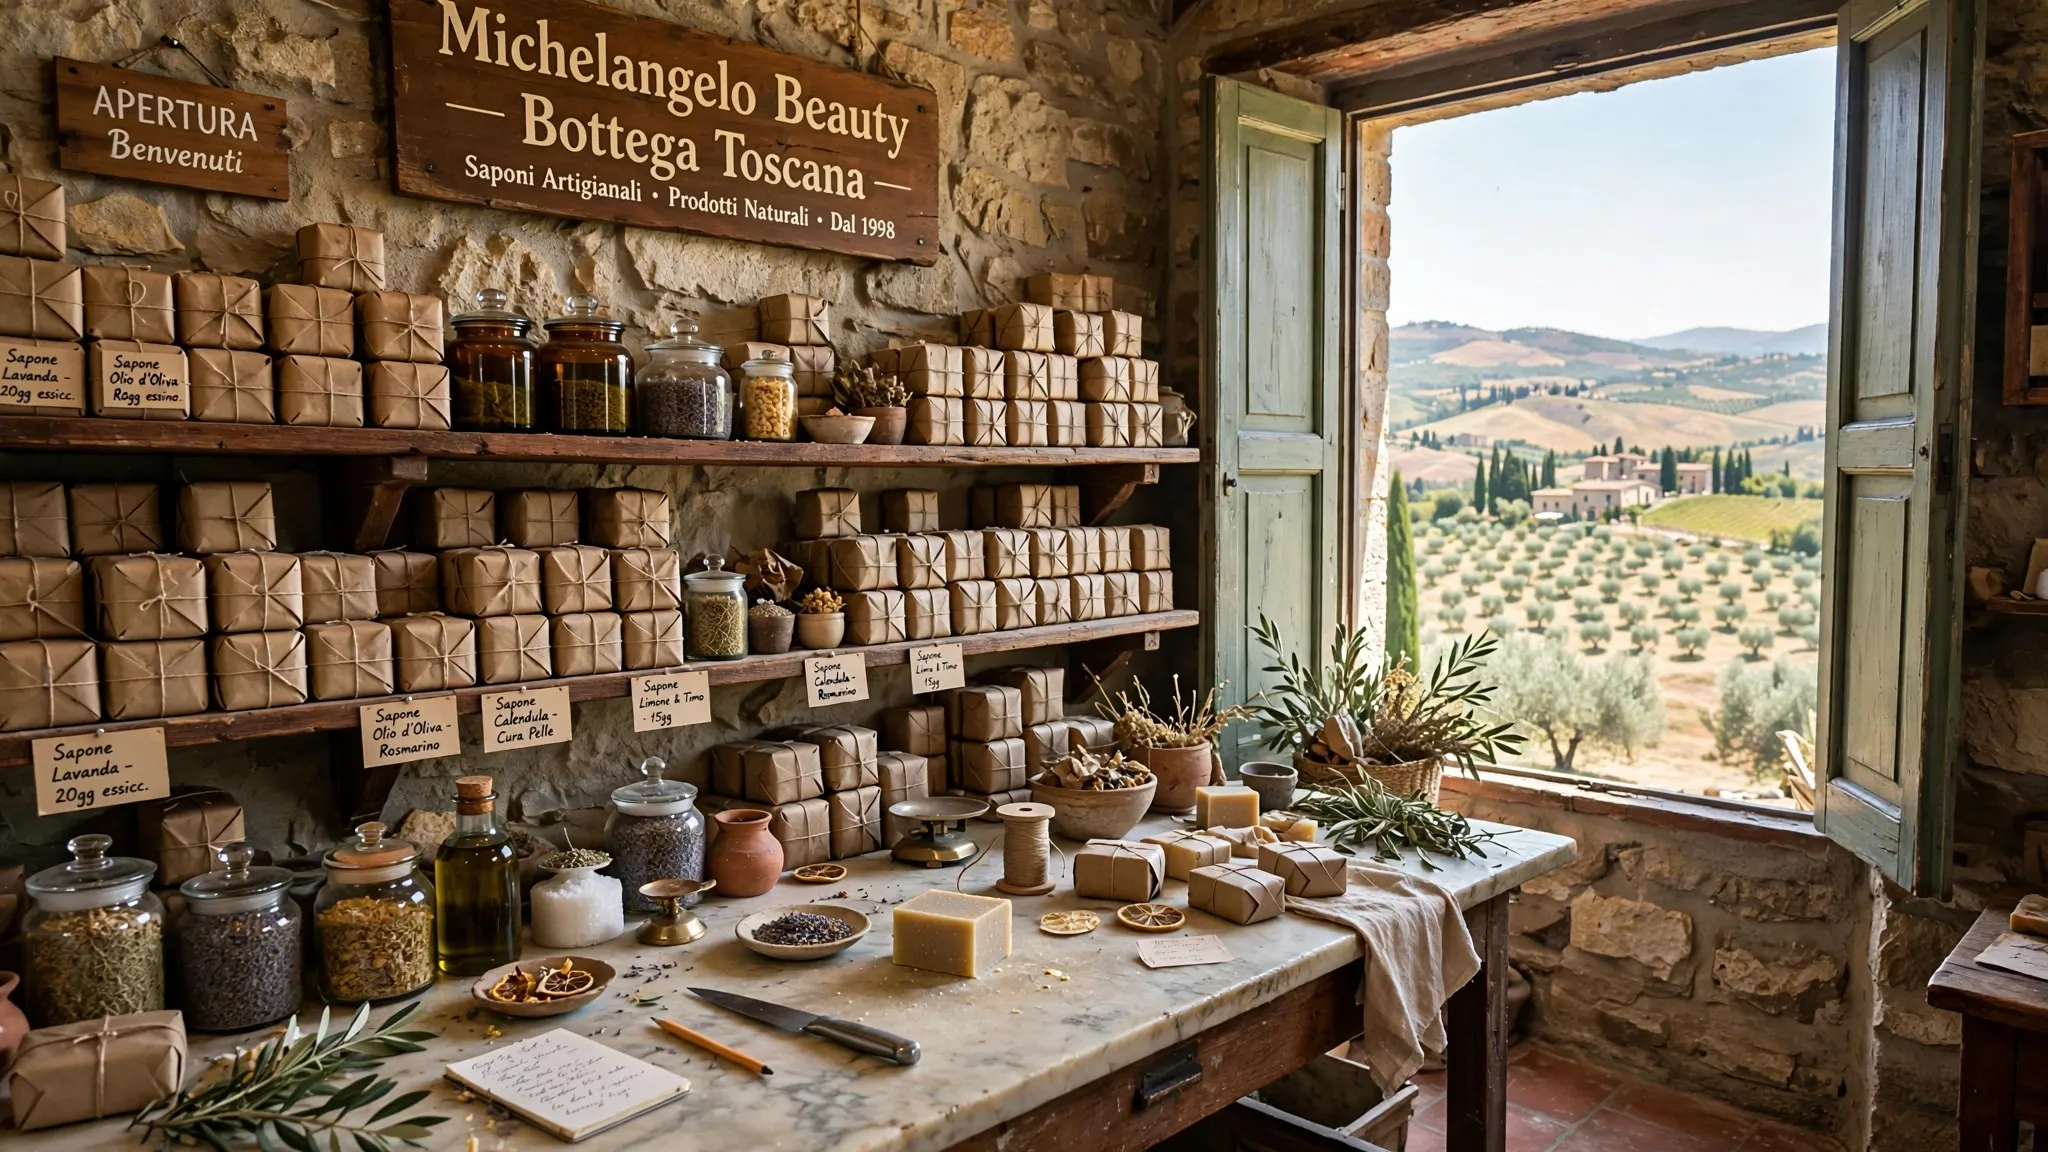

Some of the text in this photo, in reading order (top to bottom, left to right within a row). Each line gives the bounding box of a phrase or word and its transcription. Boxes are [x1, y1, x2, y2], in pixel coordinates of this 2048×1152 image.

[437, 0, 910, 159] Michelangelo Beauty
[92, 85, 258, 142] APERTURA
[107, 128, 244, 174] Benvenuti
[520, 92, 867, 200] Bottega Toscana
[464, 154, 896, 240] Saponi Artigianali Prodotti Naturali Dal 1998
[6, 348, 58, 369] Sapone
[113, 354, 160, 372] Sapone
[2, 367, 59, 383] Lavanda
[110, 371, 179, 388] Olio d'Oliva
[0, 385, 75, 404] 20gg essicc.
[643, 680, 679, 696] Sapone
[495, 697, 536, 712] Sapone
[639, 691, 705, 709] Limone & Timo
[375, 708, 420, 726] Sapone
[494, 708, 549, 728] Calendula
[650, 711, 672, 727] 15gg
[372, 726, 397, 741] Olio
[401, 721, 443, 737] d'Oliva
[496, 724, 554, 744] Cura Pelle
[53, 743, 113, 764] Sapone
[379, 740, 440, 759] Rosmarino
[51, 760, 119, 783] Lavanda
[55, 780, 149, 808] 20gg essicc.
